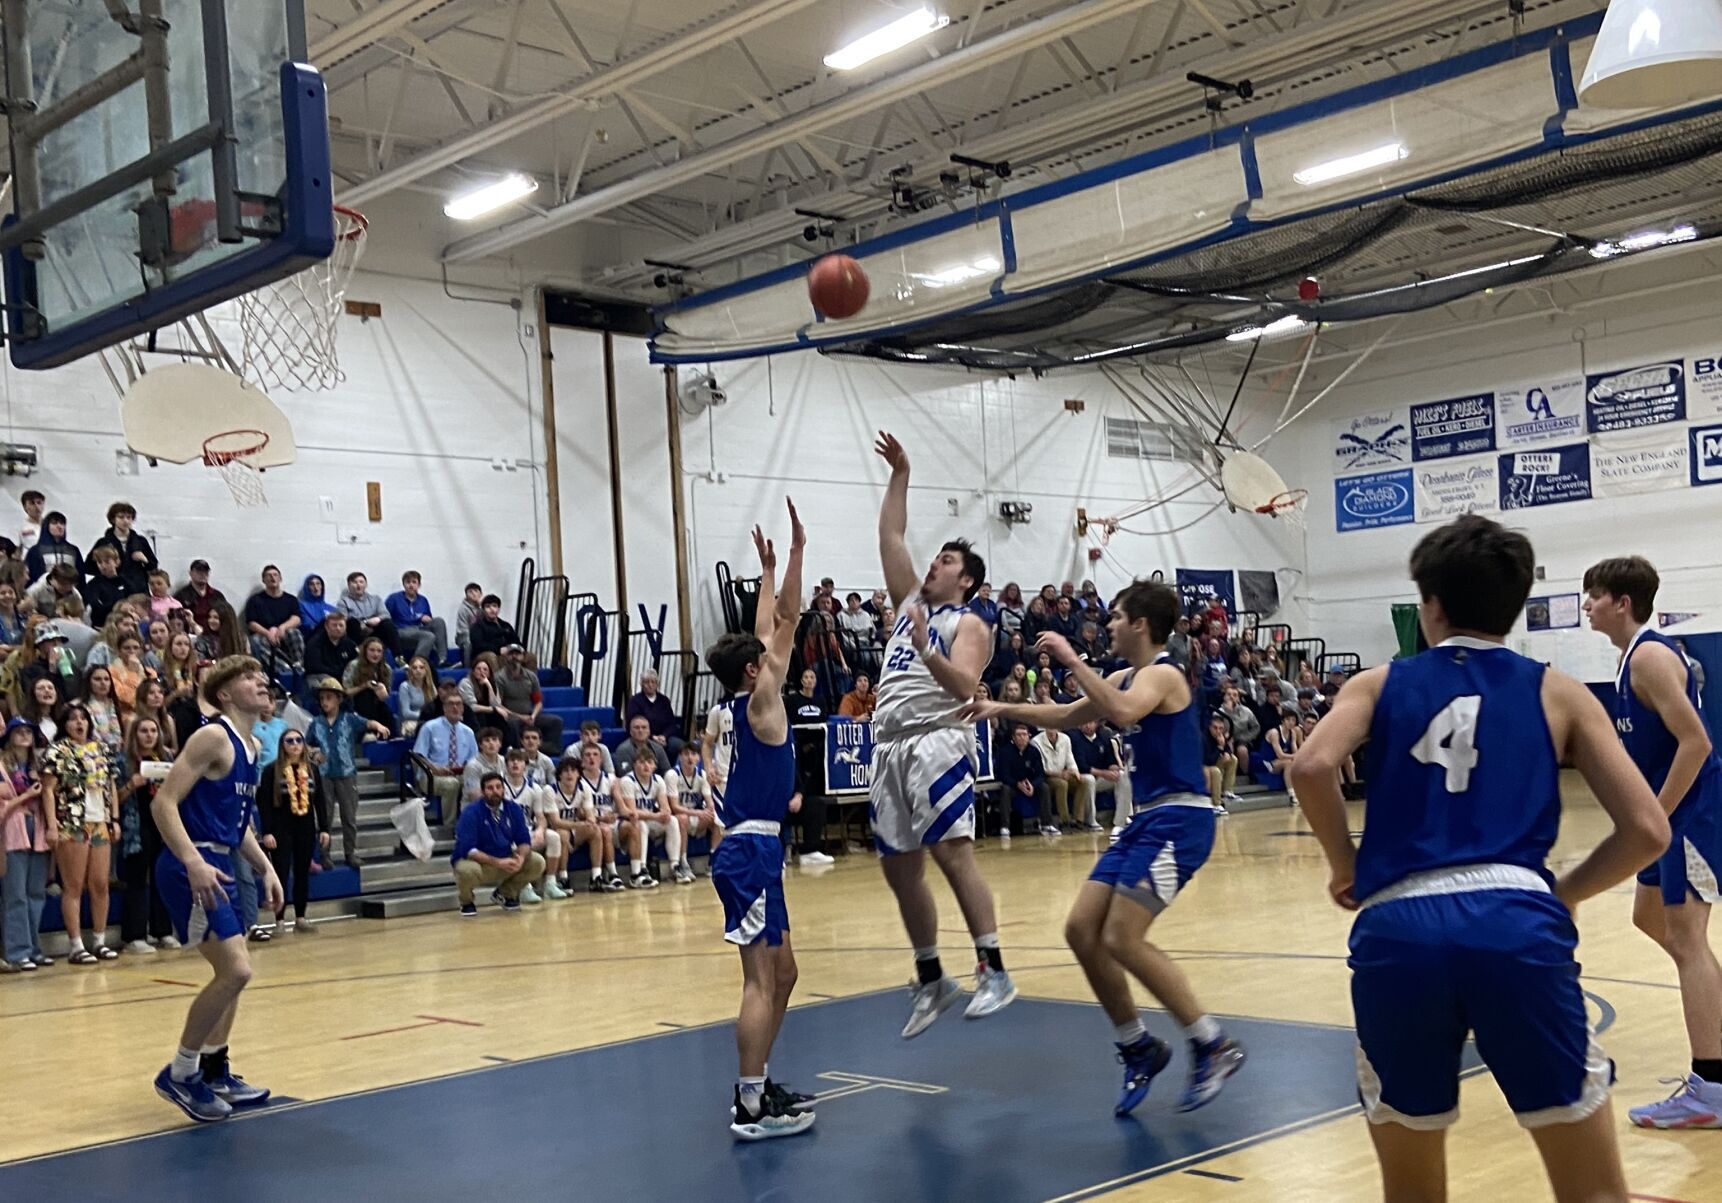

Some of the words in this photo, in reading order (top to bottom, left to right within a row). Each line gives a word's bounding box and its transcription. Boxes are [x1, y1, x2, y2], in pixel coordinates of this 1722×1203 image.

[1520, 454, 1553, 463] OTTERS
[1595, 456, 1614, 468] THE
[1615, 453, 1638, 465] NEW
[1640, 447, 1688, 462] ENGLAND
[1601, 467, 1629, 479] SLATE
[1632, 460, 1681, 474] COMPANY
[1556, 479, 1590, 492] Covering
[887, 646, 916, 672] 22
[836, 722, 864, 746] OTTER
[1409, 694, 1482, 794] 4
